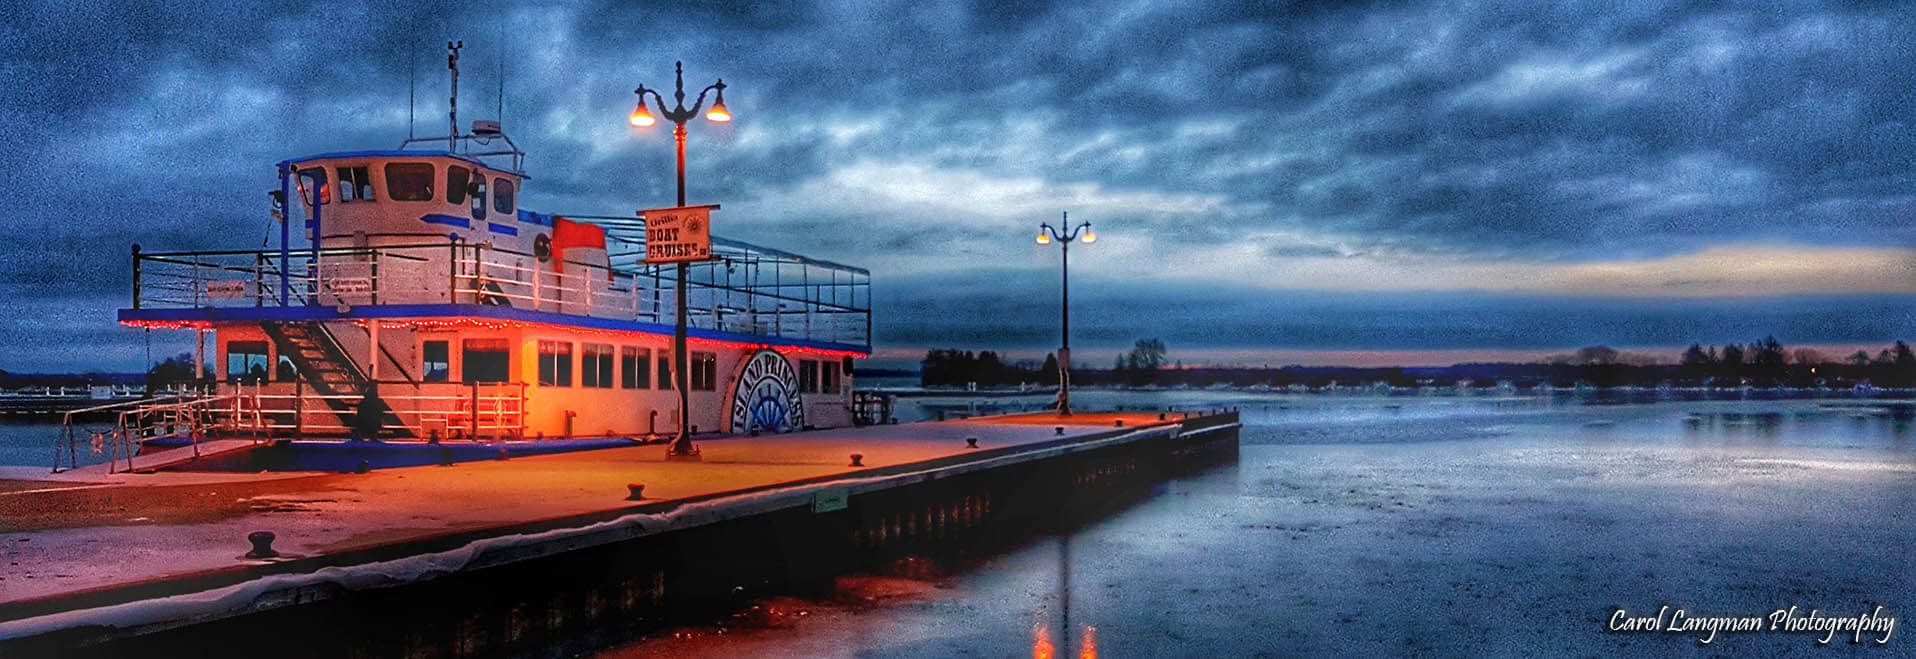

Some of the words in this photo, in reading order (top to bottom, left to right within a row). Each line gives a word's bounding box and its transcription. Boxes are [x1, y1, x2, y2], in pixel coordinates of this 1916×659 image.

[648, 228, 680, 242] BOAT
[648, 243, 698, 258] CRUISES
[734, 358, 763, 428] ISLAND
